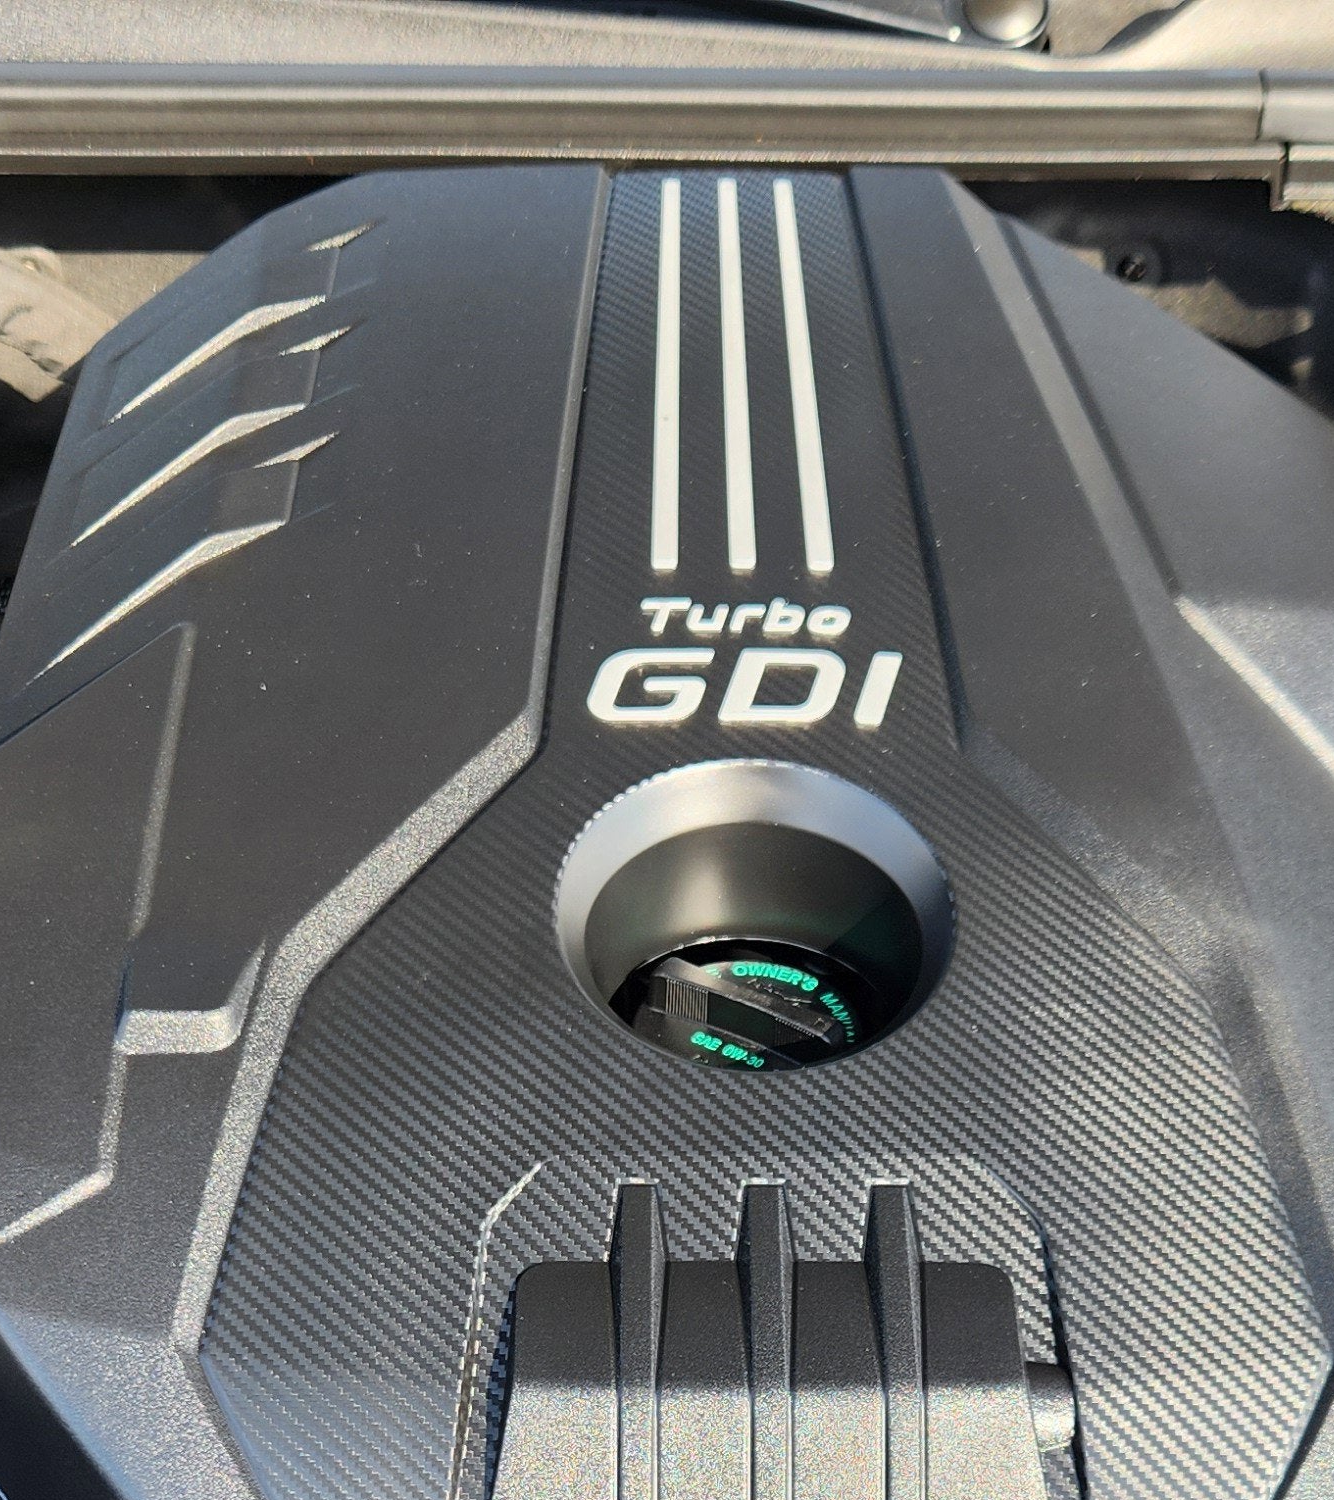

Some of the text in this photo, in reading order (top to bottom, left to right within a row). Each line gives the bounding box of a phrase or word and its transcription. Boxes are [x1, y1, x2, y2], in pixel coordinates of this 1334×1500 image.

[641, 597, 852, 636] Turbo
[586, 647, 903, 728] GDI
[730, 961, 819, 992] OWNER'S
[690, 1031, 723, 1051] SAE
